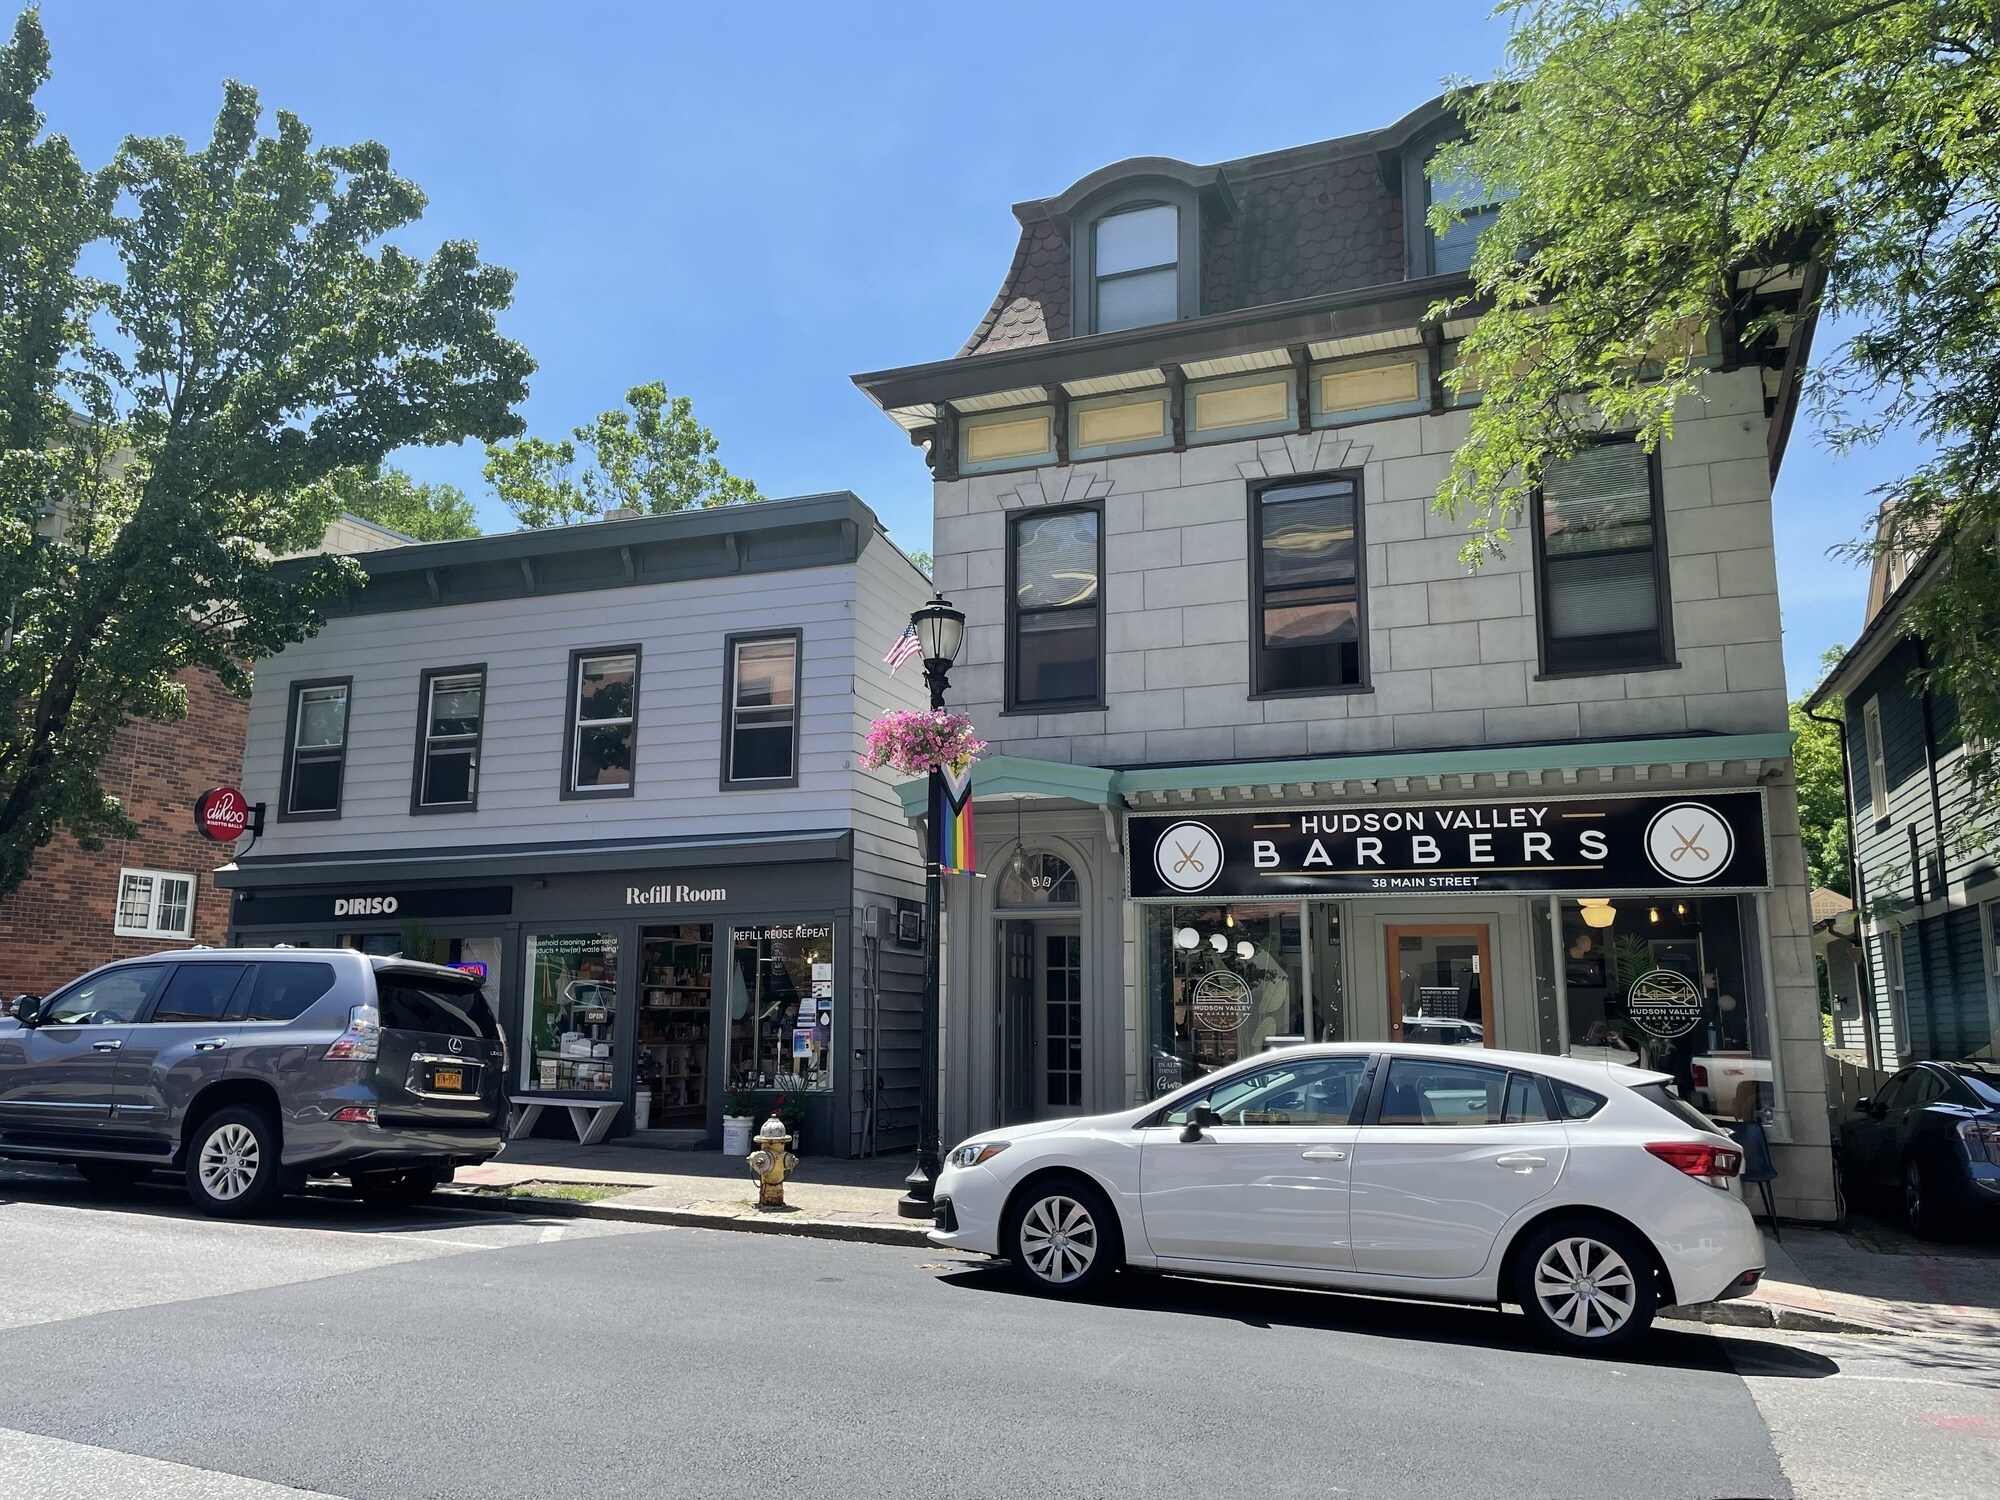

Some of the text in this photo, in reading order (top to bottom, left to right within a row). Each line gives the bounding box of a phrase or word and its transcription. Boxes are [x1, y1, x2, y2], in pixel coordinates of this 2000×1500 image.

[1301, 807, 1549, 834] HUDSON VALLEY
[1253, 830, 1609, 868] BARBERS
[1032, 877, 1051, 887] 38
[1372, 876, 1479, 888] 38 MAIN STREET
[626, 884, 727, 904] Refill Room
[334, 896, 399, 916] DIRISO
[733, 927, 830, 941] REFILL REUSE REPEAT
[559, 939, 586, 947] cleaning
[591, 937, 618, 947] personal
[588, 1012, 604, 1020] OPEN
